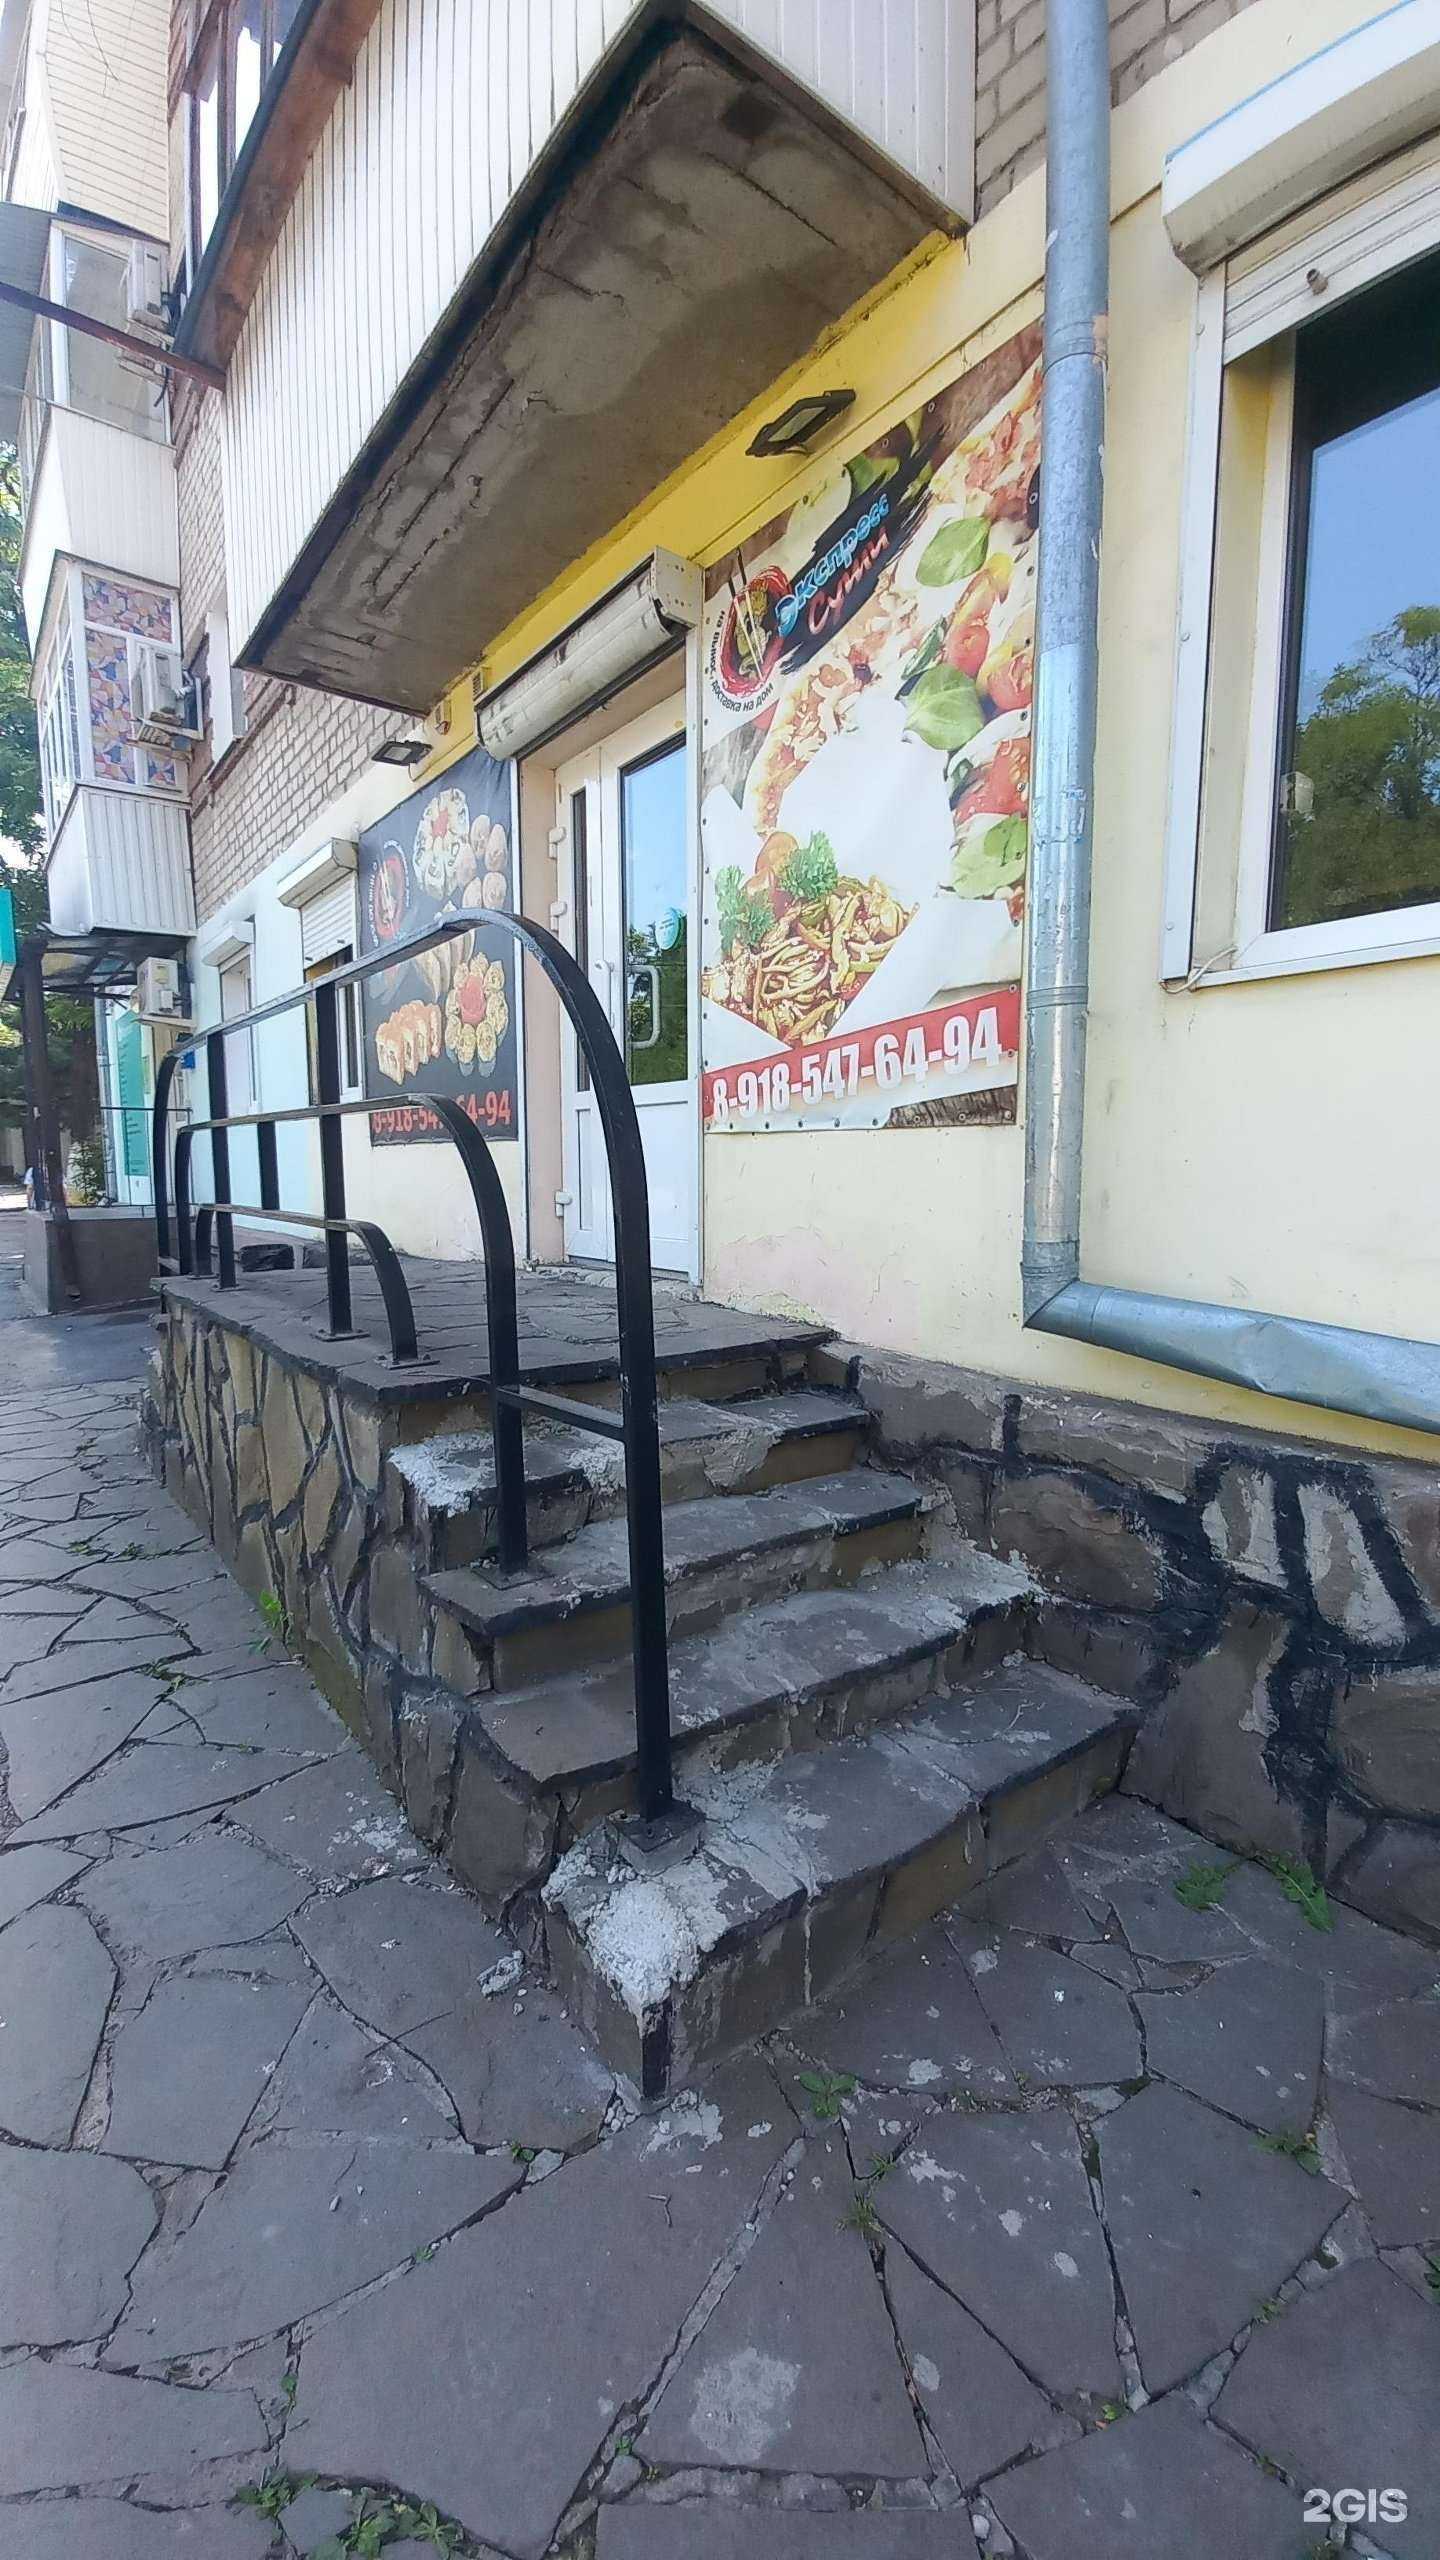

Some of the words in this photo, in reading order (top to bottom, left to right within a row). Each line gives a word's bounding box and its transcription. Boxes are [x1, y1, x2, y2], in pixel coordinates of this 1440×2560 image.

[742, 700, 755, 712] на
[755, 682, 774, 708] дом
[712, 1006, 1003, 1122] 8-918-547-64-94
